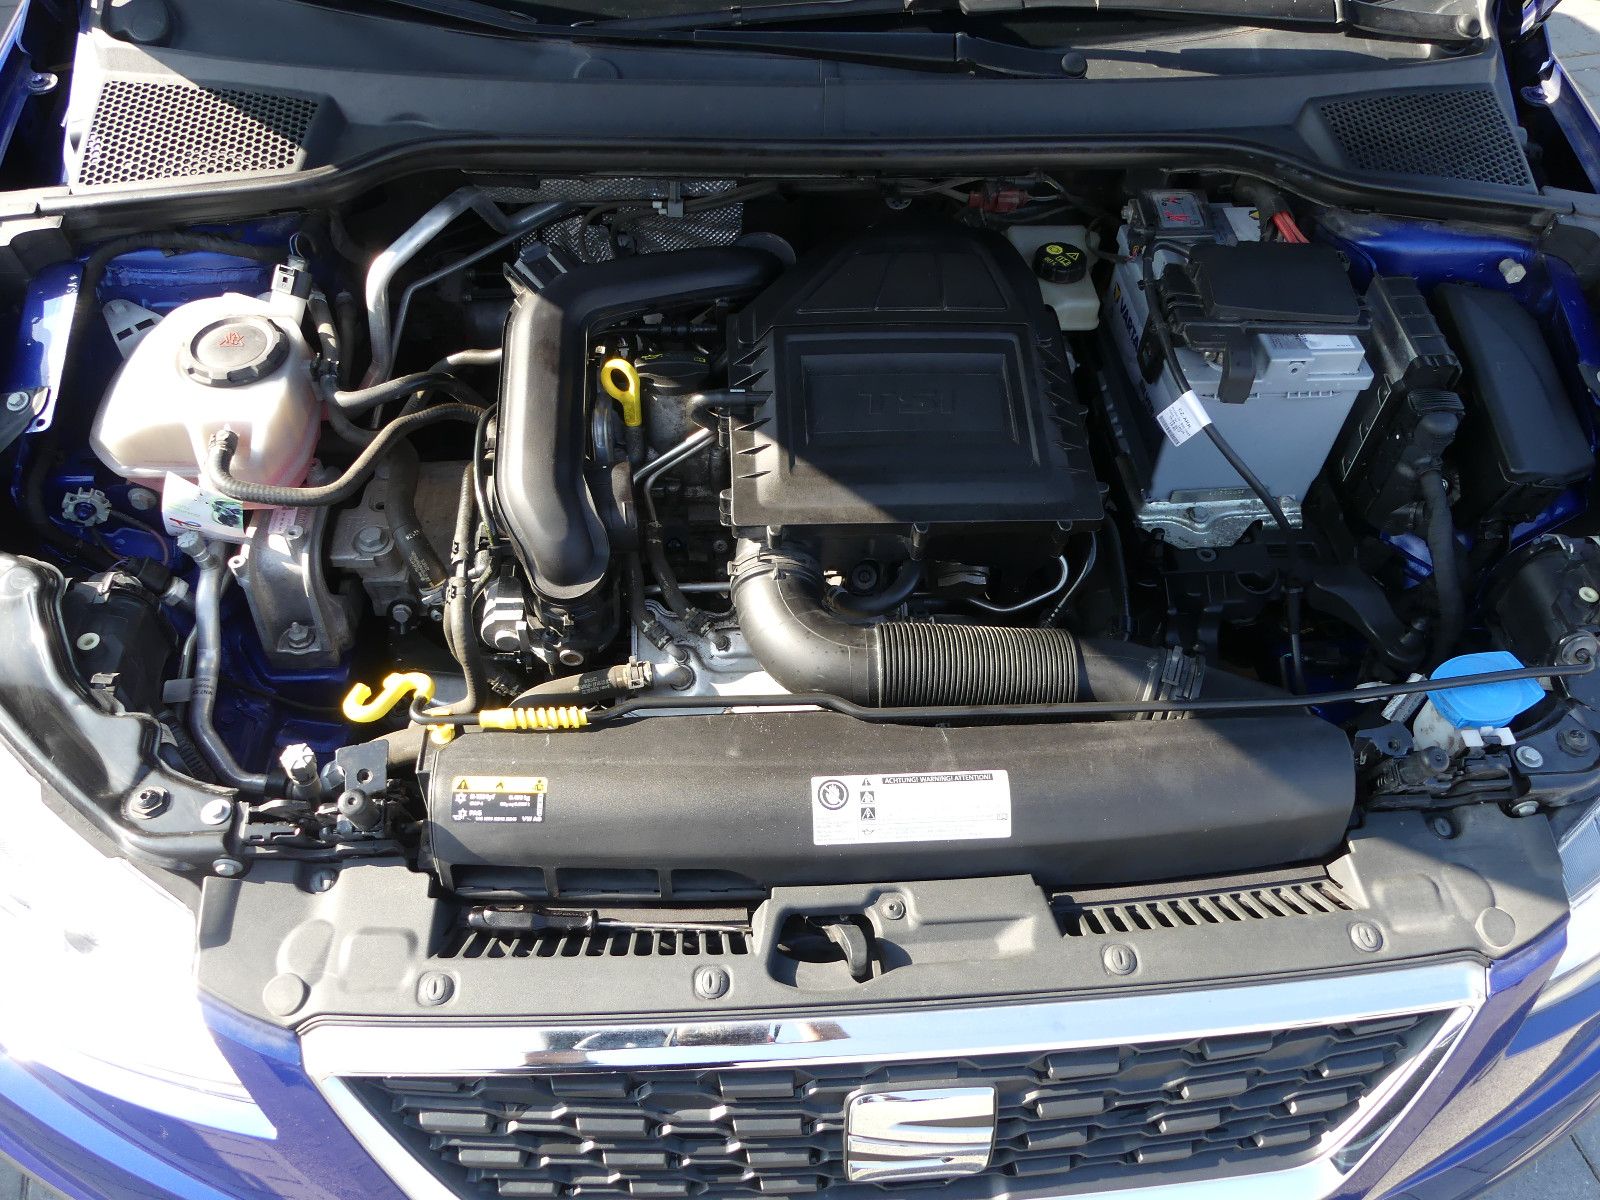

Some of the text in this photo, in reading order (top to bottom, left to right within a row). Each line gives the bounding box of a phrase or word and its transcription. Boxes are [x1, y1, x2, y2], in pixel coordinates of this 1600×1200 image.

[1120, 296, 1139, 352] VARTA
[855, 391, 954, 415] TSI
[884, 773, 992, 784] ACHTUNG! WARNING! ATTENTION!
